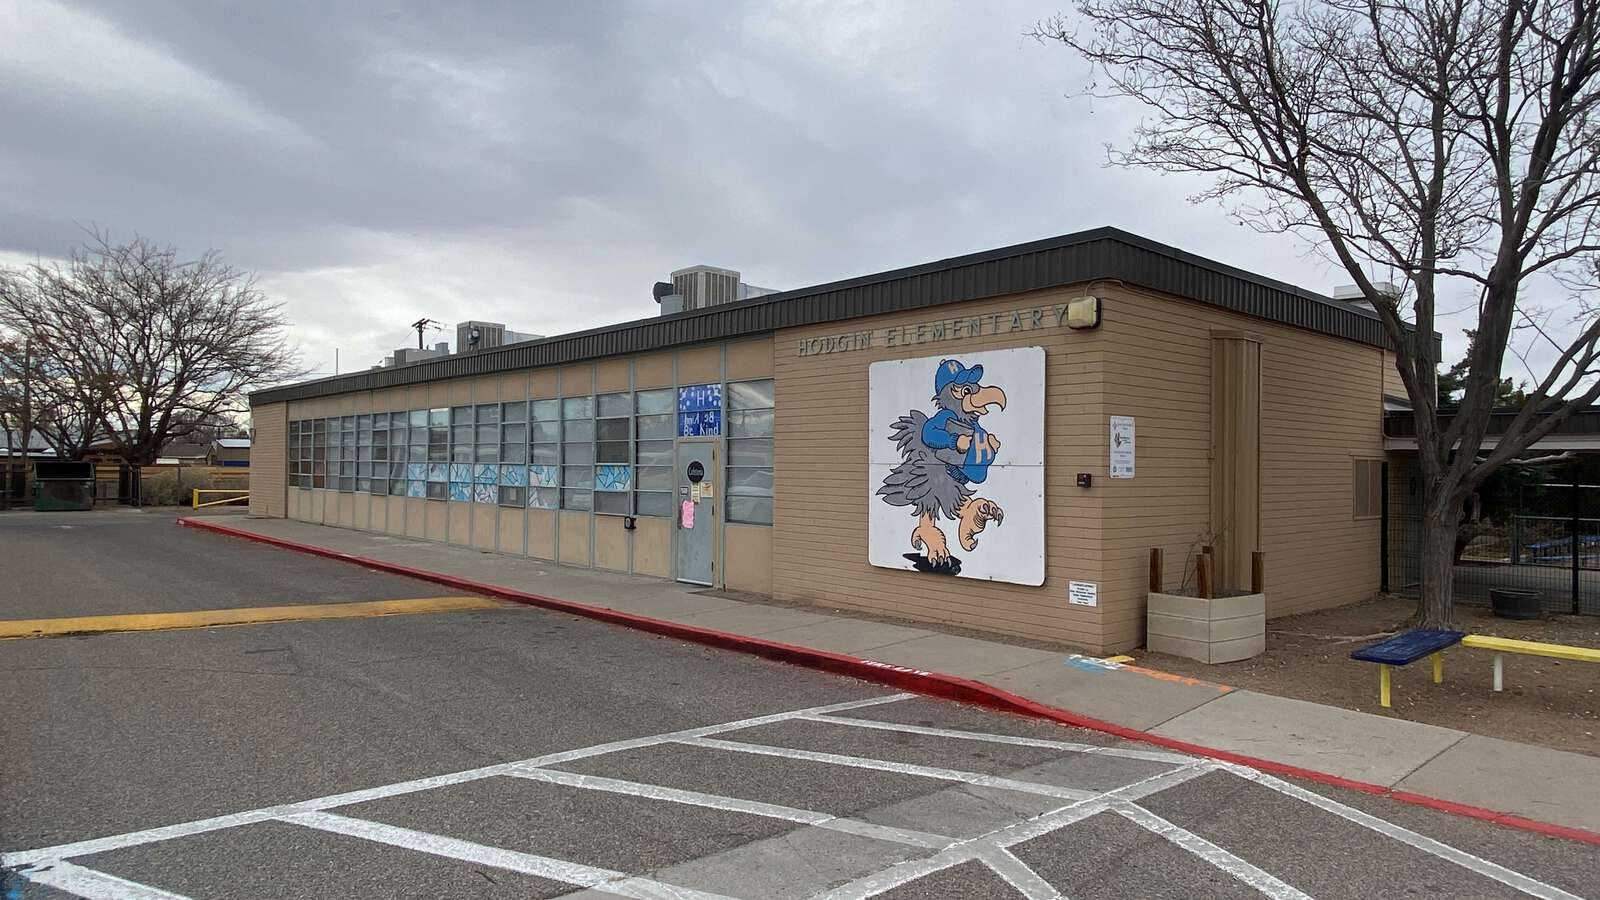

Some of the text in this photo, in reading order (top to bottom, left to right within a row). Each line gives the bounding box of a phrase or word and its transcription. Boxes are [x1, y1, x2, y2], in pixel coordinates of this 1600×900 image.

[798, 303, 1070, 357] HODGIN ELEMENTARY
[947, 361, 959, 374] H
[696, 390, 705, 407] H
[683, 422, 719, 437] Be Kind
[974, 431, 992, 464] H
